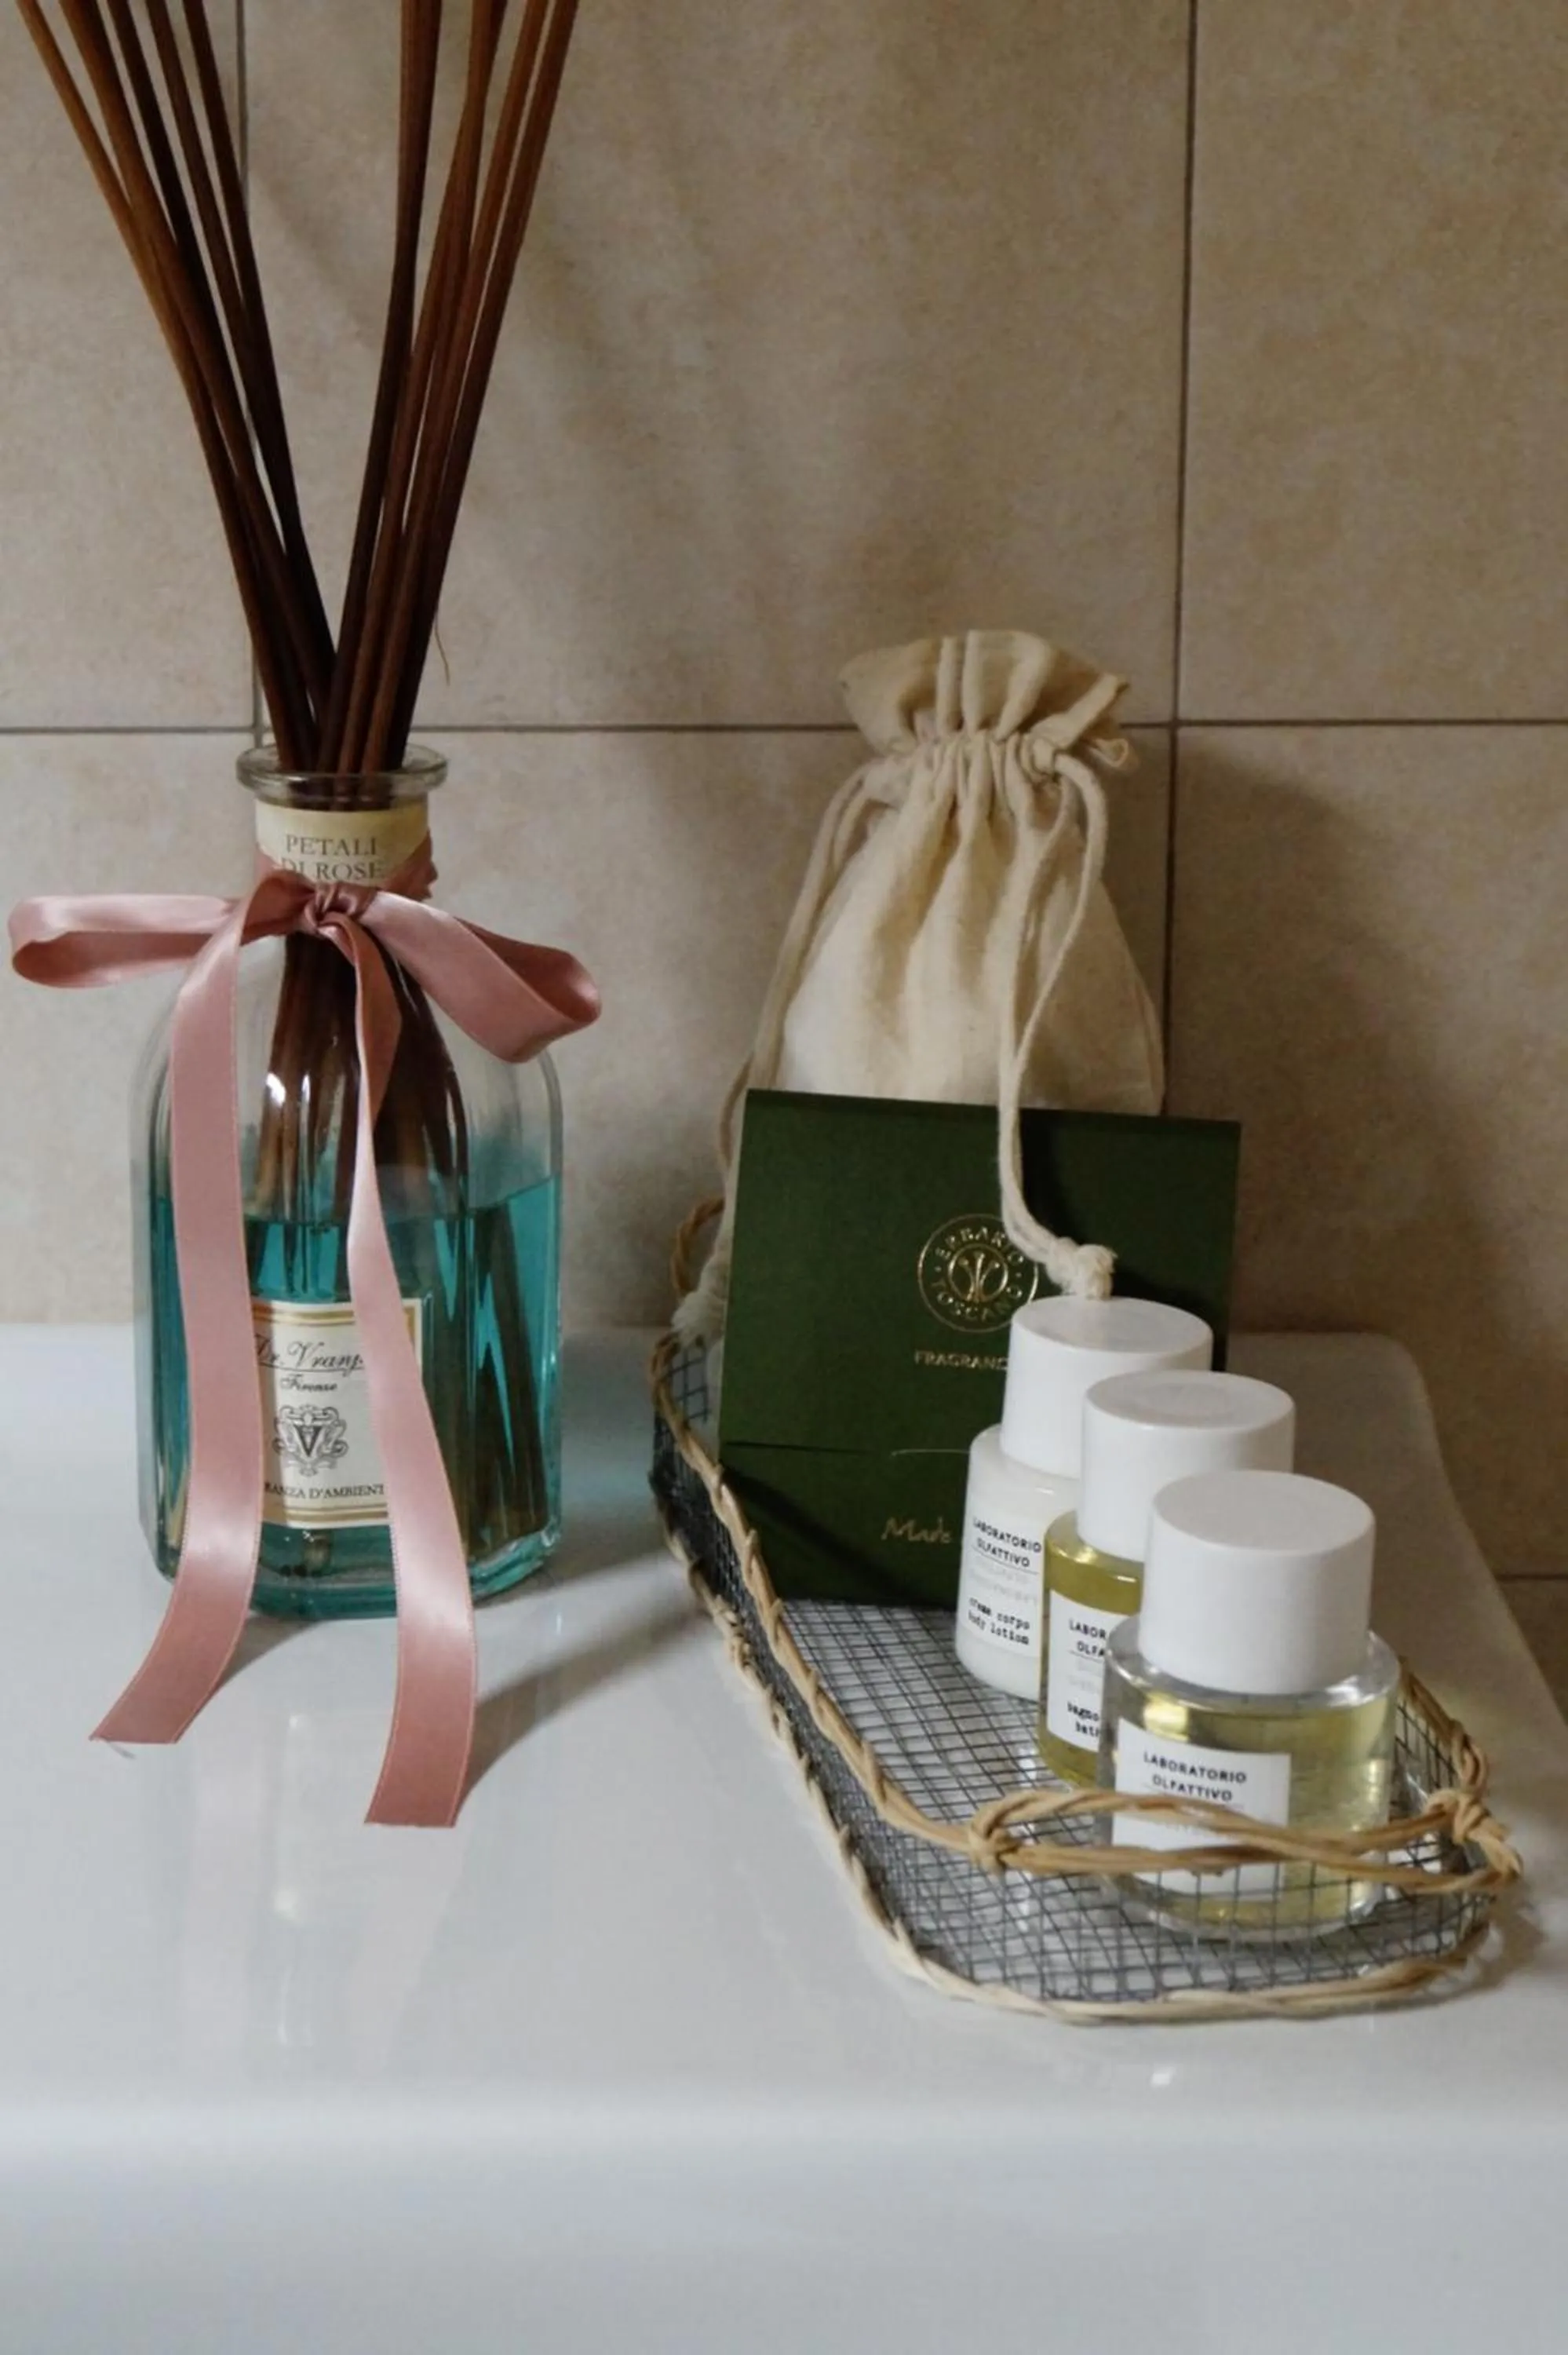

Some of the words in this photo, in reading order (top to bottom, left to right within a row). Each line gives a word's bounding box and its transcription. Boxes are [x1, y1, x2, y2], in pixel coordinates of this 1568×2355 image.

[285, 834, 378, 856] PETALI
[281, 857, 305, 876] DI
[315, 861, 387, 881] ROSE
[287, 1342, 363, 1378] Vranj
[279, 1375, 338, 1393] Firenze
[881, 1515, 953, 1544] Made
[972, 1515, 1042, 1554] LABORATORIO
[976, 1536, 1030, 1568] OLFATTIVO
[968, 1609, 986, 1631] body
[990, 1623, 1030, 1645] lotion
[997, 1612, 1030, 1630] corpo
[1143, 1751, 1247, 1784] LABORATORIO
[1152, 1773, 1233, 1802] OLFATTIVO
